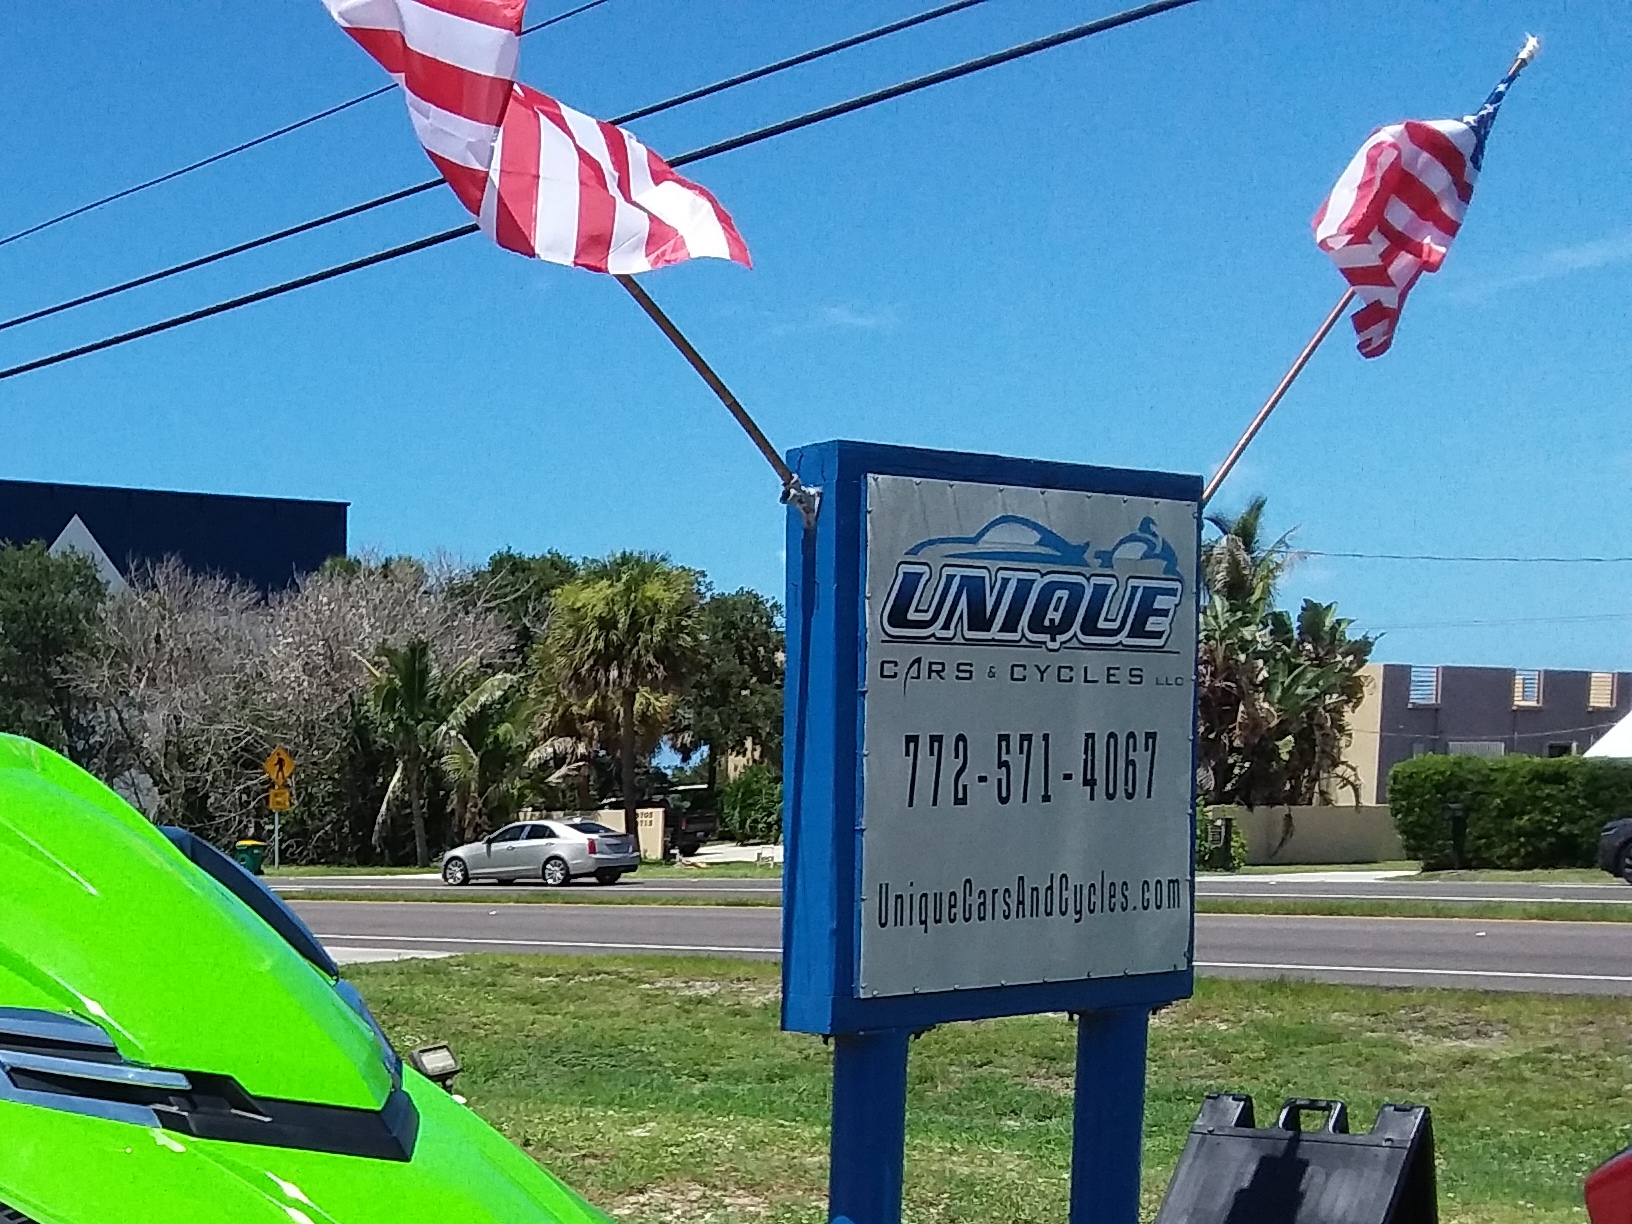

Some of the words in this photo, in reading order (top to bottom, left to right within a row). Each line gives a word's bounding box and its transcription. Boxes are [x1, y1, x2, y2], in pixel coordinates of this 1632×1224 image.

[881, 561, 1183, 651] UNIQUE
[879, 656, 975, 697] CARS
[986, 665, 997, 679] &
[1009, 664, 1145, 686] CYCLES
[1155, 675, 1185, 687] LLC
[904, 731, 1158, 808] 772-571-4067
[877, 869, 1181, 934] UniqueCarsAndCycles.com
